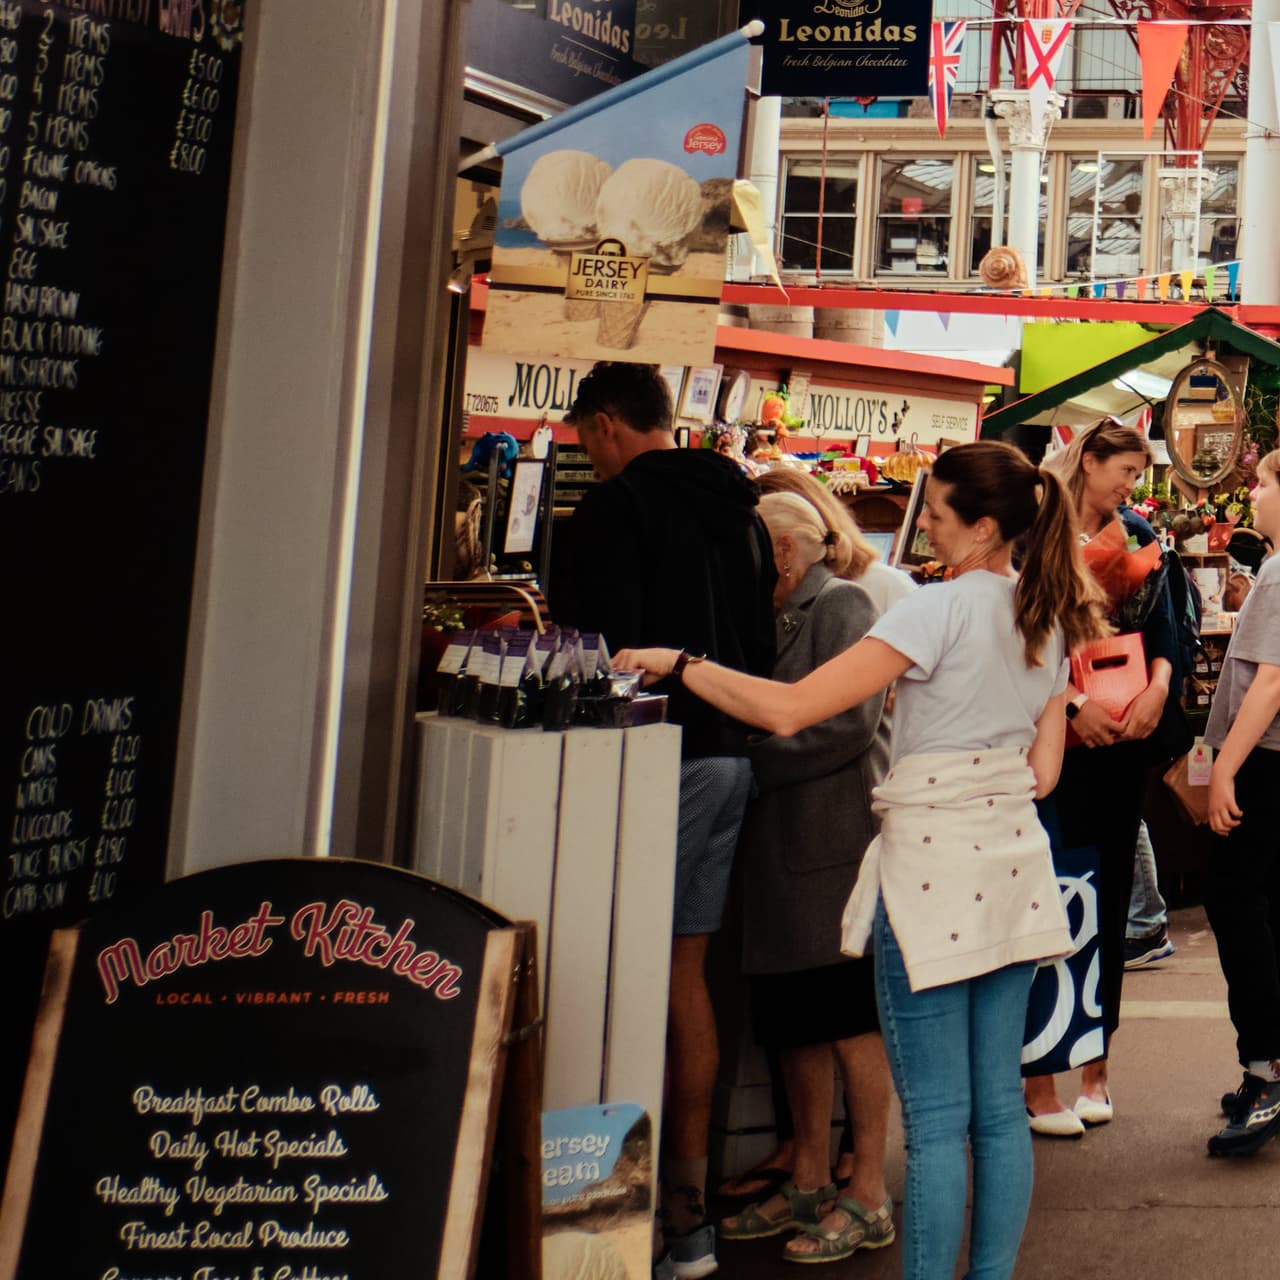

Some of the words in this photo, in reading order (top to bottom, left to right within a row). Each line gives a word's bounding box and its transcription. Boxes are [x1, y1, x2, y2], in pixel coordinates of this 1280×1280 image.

[39, 8, 56, 45] 2
[68, 13, 112, 57] ITEMS
[777, 18, 918, 43] Leonidas
[35, 41, 50, 75] 3
[62, 50, 105, 88] ITEMS
[809, 53, 854, 72] Belgian
[854, 52, 910, 68] Chocolates
[56, 80, 100, 121] ITEMS
[26, 110, 42, 143] 5
[44, 112, 91, 153] ITEMS
[686, 138, 724, 153] Jersey
[571, 258, 644, 279] JERSEY
[584, 278, 629, 290] DAIRY
[807, 392, 888, 435] MOLLOY'S
[25, 701, 74, 742] COLD
[97, 899, 286, 1005] Market
[290, 898, 464, 1001] Kitchen
[155, 991, 213, 1007] LOCAL
[235, 990, 313, 1007] VIBRANT
[332, 990, 391, 1007] FRESH
[131, 1084, 241, 1126] Breakfast
[239, 1083, 316, 1115] Combo
[318, 1083, 381, 1118] Rolls
[148, 1128, 210, 1173] Daily
[212, 1128, 263, 1160] Hot
[262, 1127, 350, 1171] Specials
[541, 1131, 612, 1161] ersey
[542, 1160, 601, 1188] eam
[95, 1175, 181, 1218] Healthy
[184, 1175, 300, 1218] Vegetarian
[301, 1172, 391, 1215] Specials
[119, 1220, 190, 1252] Finest
[188, 1219, 254, 1252] Local
[256, 1218, 351, 1252] Produce
